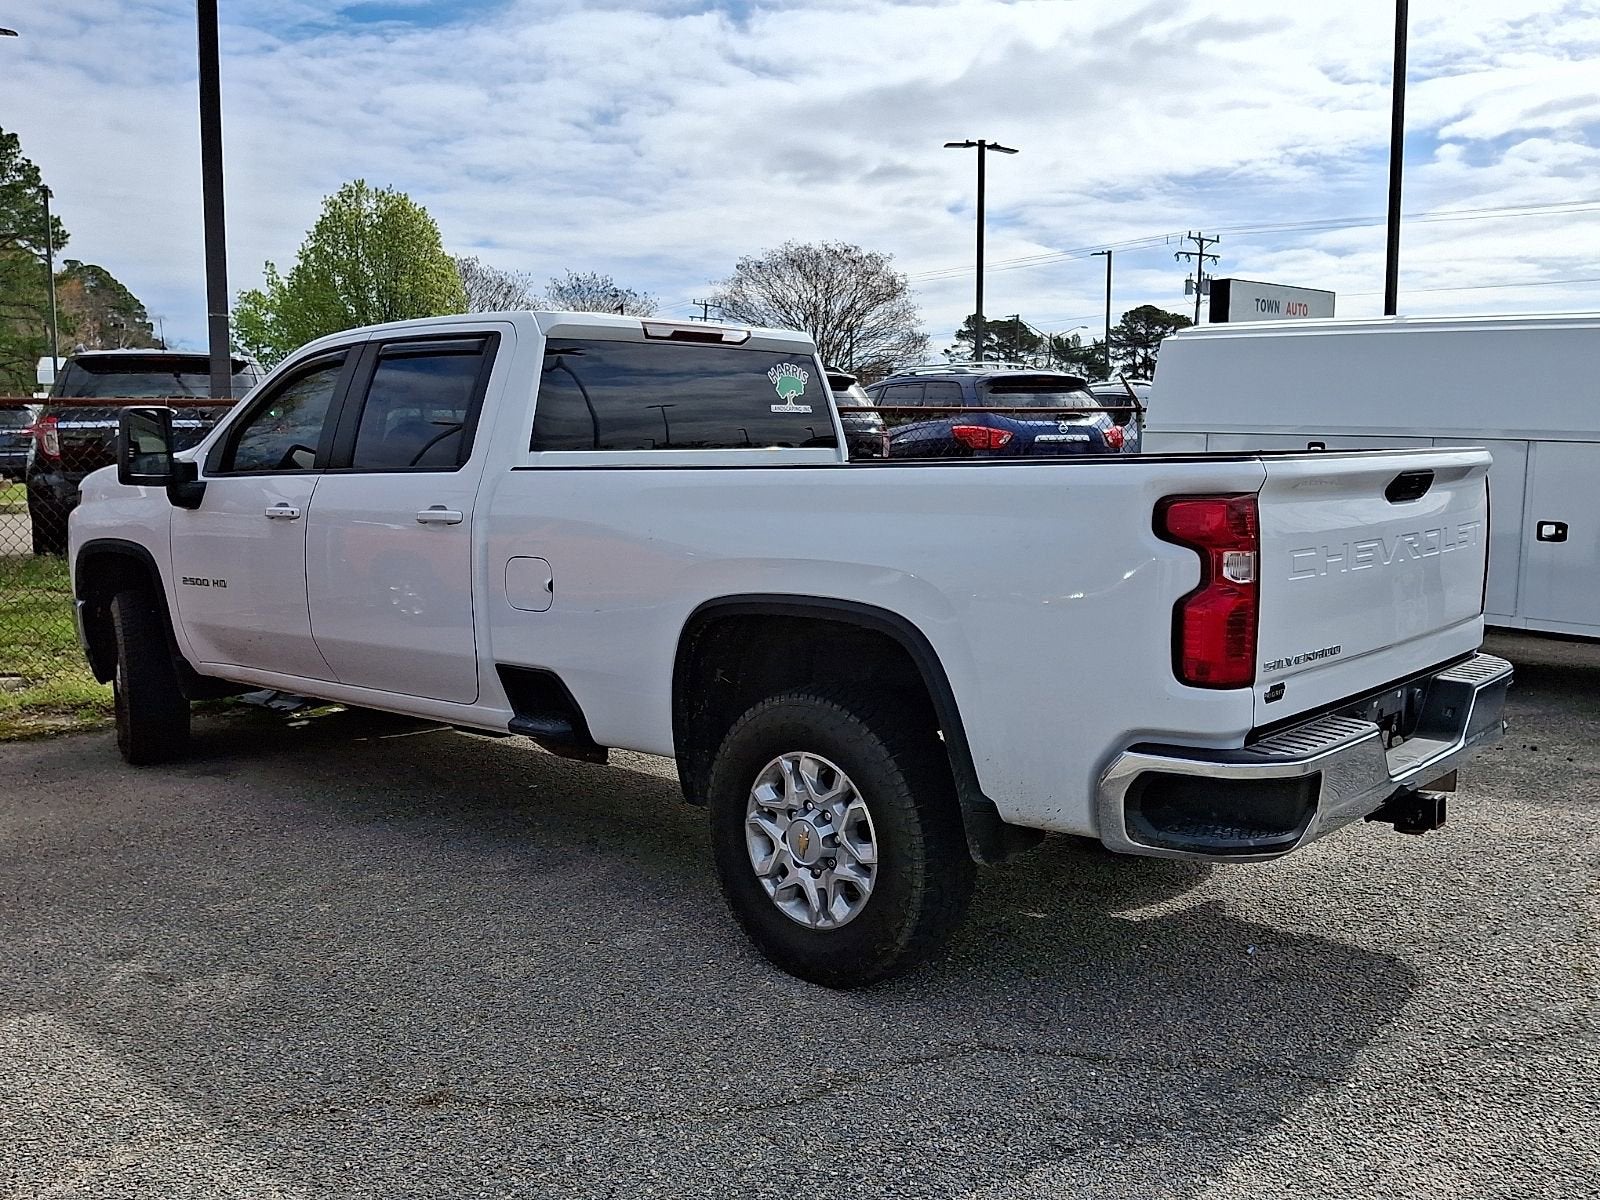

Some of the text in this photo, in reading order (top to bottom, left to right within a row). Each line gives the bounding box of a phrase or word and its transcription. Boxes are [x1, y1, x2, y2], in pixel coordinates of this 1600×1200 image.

[1255, 298, 1308, 317] TOWN AUTO
[767, 362, 809, 385] HARRIS
[1288, 520, 1481, 581] CHEVROLET
[182, 576, 227, 588] 2500 HD
